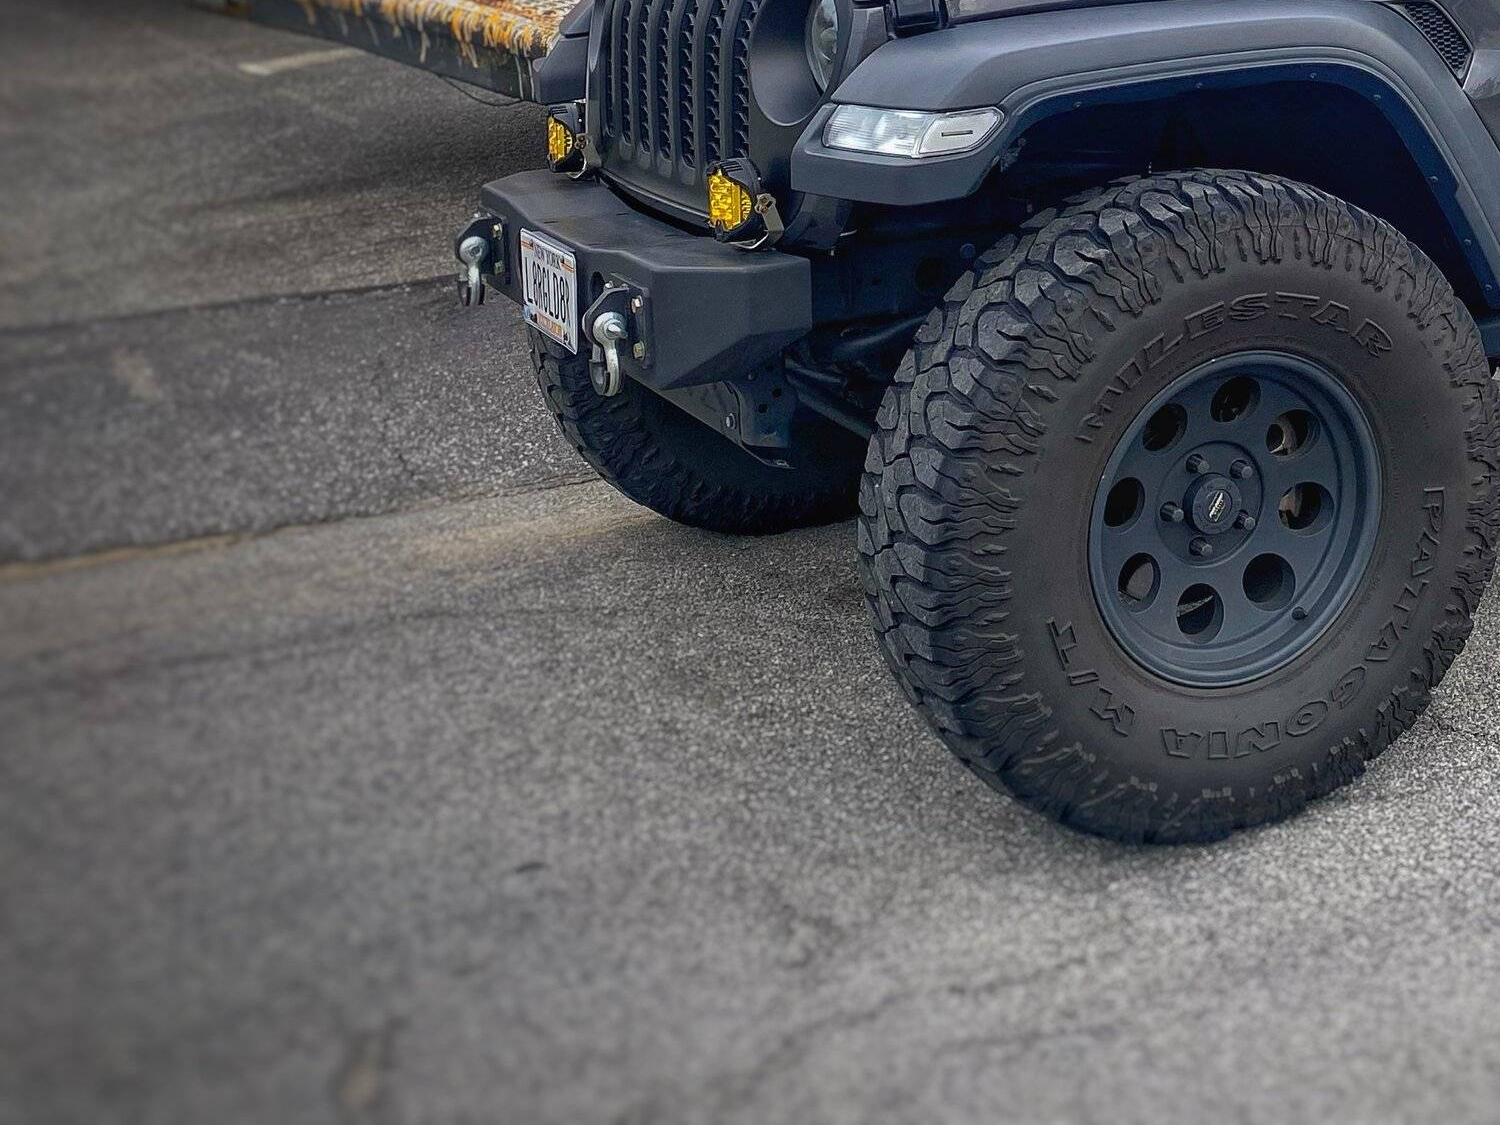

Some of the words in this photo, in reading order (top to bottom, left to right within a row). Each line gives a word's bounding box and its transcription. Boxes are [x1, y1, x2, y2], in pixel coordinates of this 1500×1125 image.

[1075, 292, 1394, 444] MILESTAR
[1046, 616, 1137, 737] M/T
[1160, 486, 1446, 760] PATAGONIA
